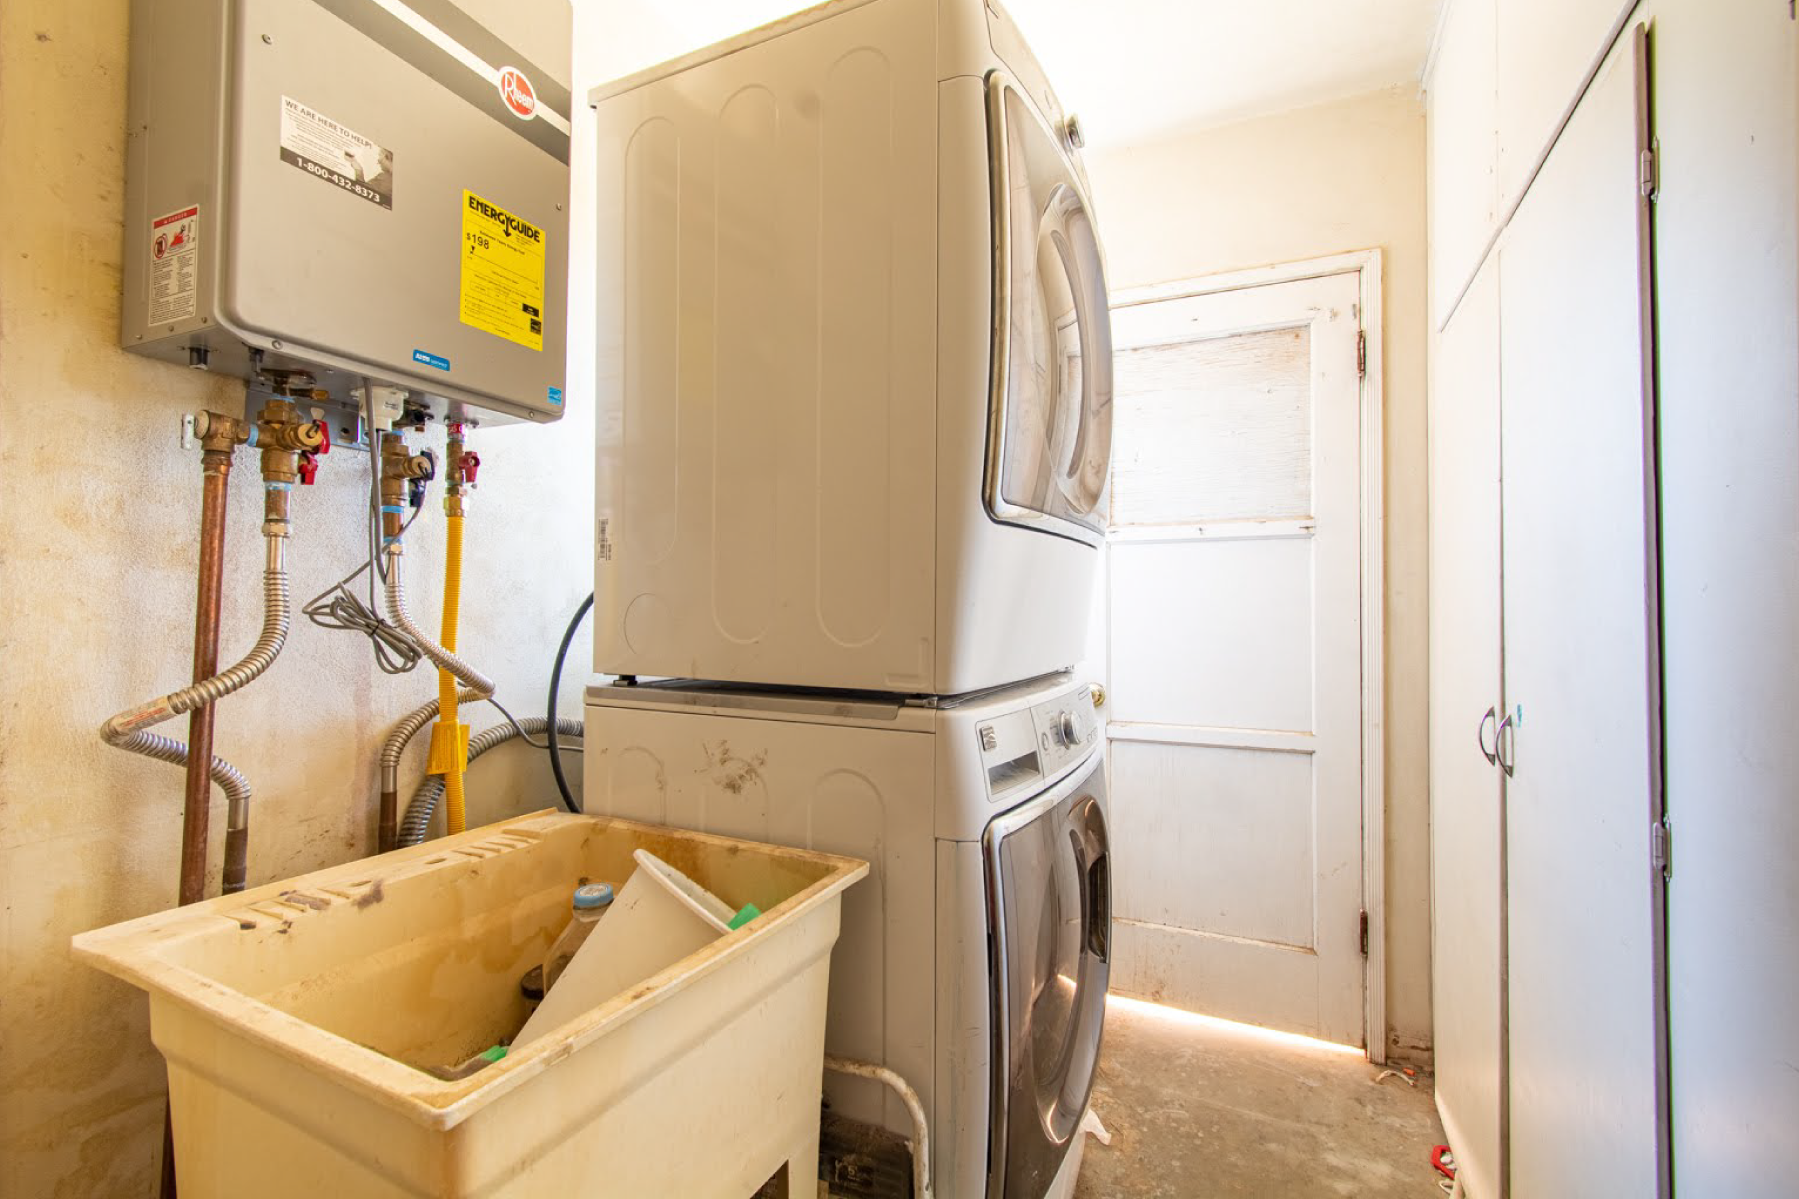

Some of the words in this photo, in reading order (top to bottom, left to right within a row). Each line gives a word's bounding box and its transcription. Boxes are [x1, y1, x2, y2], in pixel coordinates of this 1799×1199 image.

[504, 72, 534, 109] Rheem
[285, 99, 298, 111] WE
[300, 107, 316, 120] ARE
[317, 116, 338, 131] HERE
[339, 127, 350, 137] TO
[351, 133, 372, 149] HELP!
[297, 157, 380, 202] 1-800-432-8373
[466, 232, 489, 250] $198
